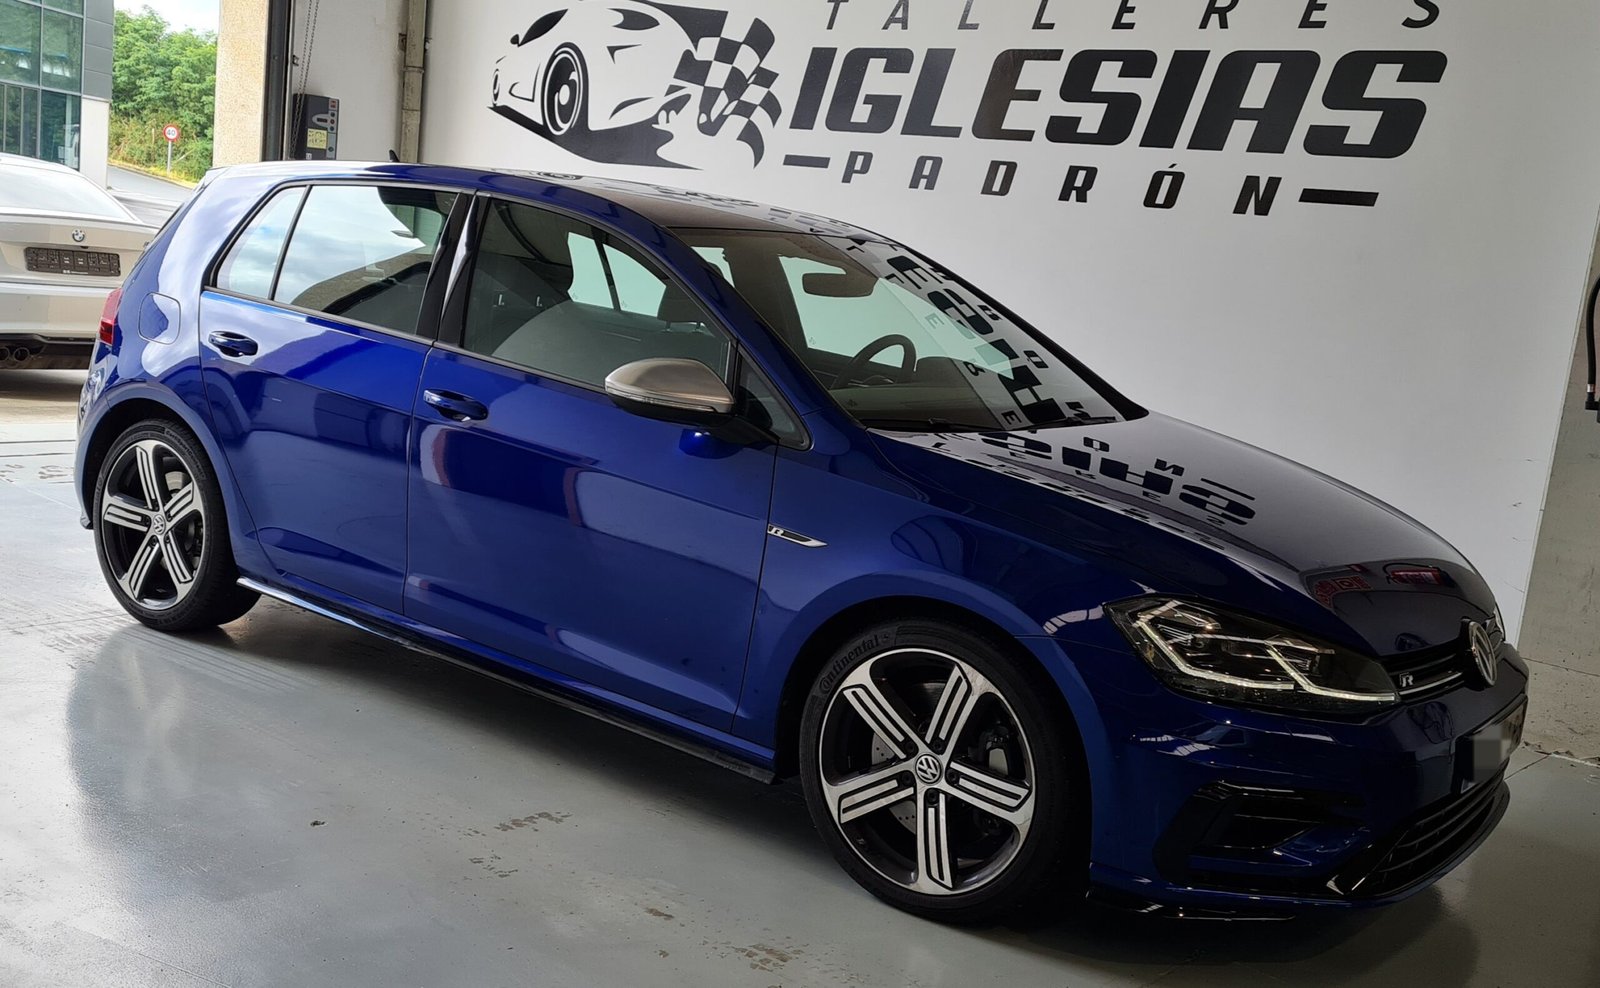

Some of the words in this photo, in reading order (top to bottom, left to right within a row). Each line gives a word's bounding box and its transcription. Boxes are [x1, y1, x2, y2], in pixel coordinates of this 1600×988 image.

[825, 0, 1440, 30] TALLERES
[789, 47, 1448, 159] IGLESIAS
[841, 150, 1283, 216] PADRÓN
[819, 635, 880, 694] Continental
